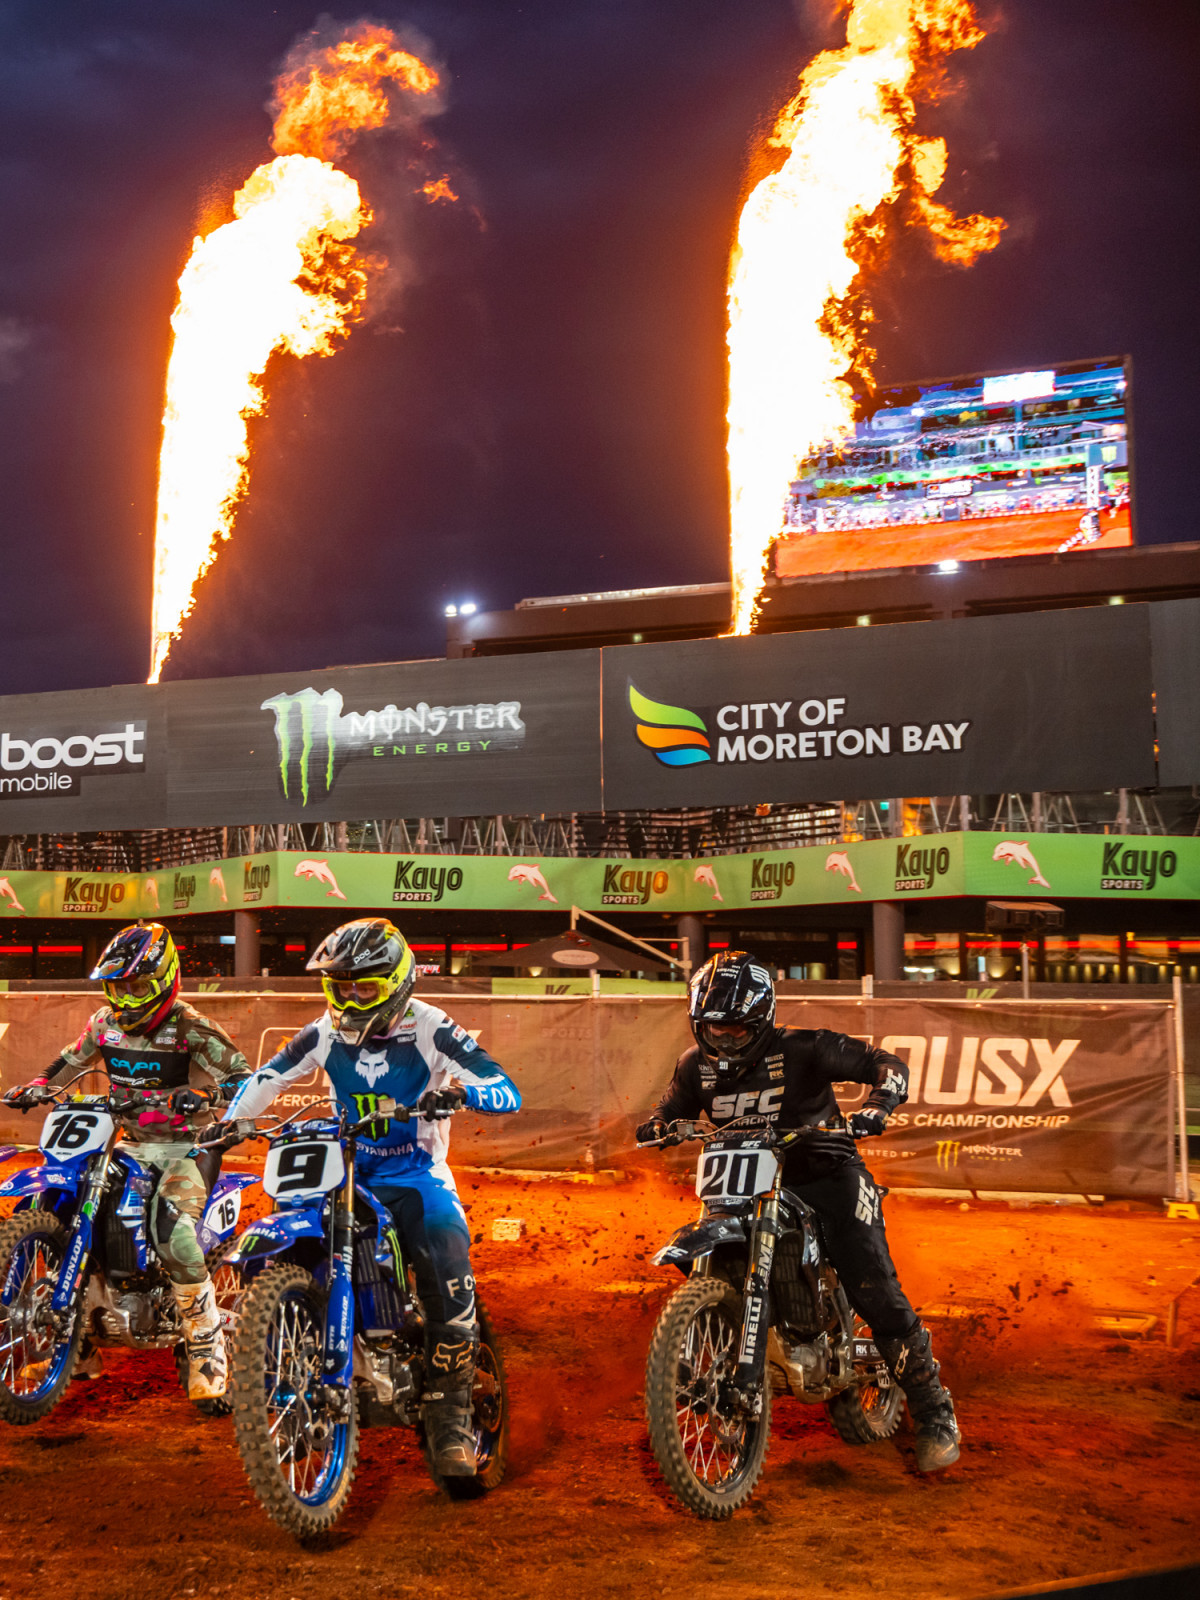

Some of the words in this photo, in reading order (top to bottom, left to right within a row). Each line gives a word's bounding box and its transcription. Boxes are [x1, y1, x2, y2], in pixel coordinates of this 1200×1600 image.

[350, 704, 522, 740] MONSTER
[716, 701, 792, 731] CITY
[798, 698, 846, 726] OF
[0, 723, 145, 771] boost
[373, 740, 491, 757] ENERGY
[717, 726, 890, 763] MORETON
[902, 722, 970, 753] BAY
[0, 772, 72, 793] mobile
[244, 861, 270, 901] Kayo
[393, 861, 464, 902] Kayo
[751, 858, 796, 899] Kayo
[895, 843, 950, 889] Kayo
[1102, 842, 1177, 890] Kayo
[64, 877, 126, 912] Kayo
[173, 872, 196, 909] Kayo
[393, 892, 432, 901] SPORTS
[602, 864, 669, 905] Kayo
[602, 895, 639, 904] SPORTS
[751, 890, 776, 900] SPORTS
[895, 879, 926, 891] SPORTS
[1101, 878, 1144, 890] SPORTS
[63, 904, 97, 912] SPORTS
[273, 1094, 332, 1108] PERCRO
[475, 1085, 517, 1110] FOX
[711, 1086, 786, 1119] SFC
[43, 1113, 99, 1150] 16
[913, 1113, 1070, 1128] CHAMPIONSHIP
[364, 1142, 414, 1157] YAMAHA
[860, 1148, 897, 1158] ENTED
[961, 1144, 1023, 1157] MONSTER
[276, 1143, 329, 1195] 9
[700, 1152, 760, 1197] 20
[217, 1198, 236, 1231] 16
[854, 1175, 876, 1226] SFC
[62, 1234, 83, 1293] DUNLOP
[446, 1274, 477, 1298] FO
[738, 1296, 762, 1365] PIRELLI
[856, 1344, 867, 1355] RK
